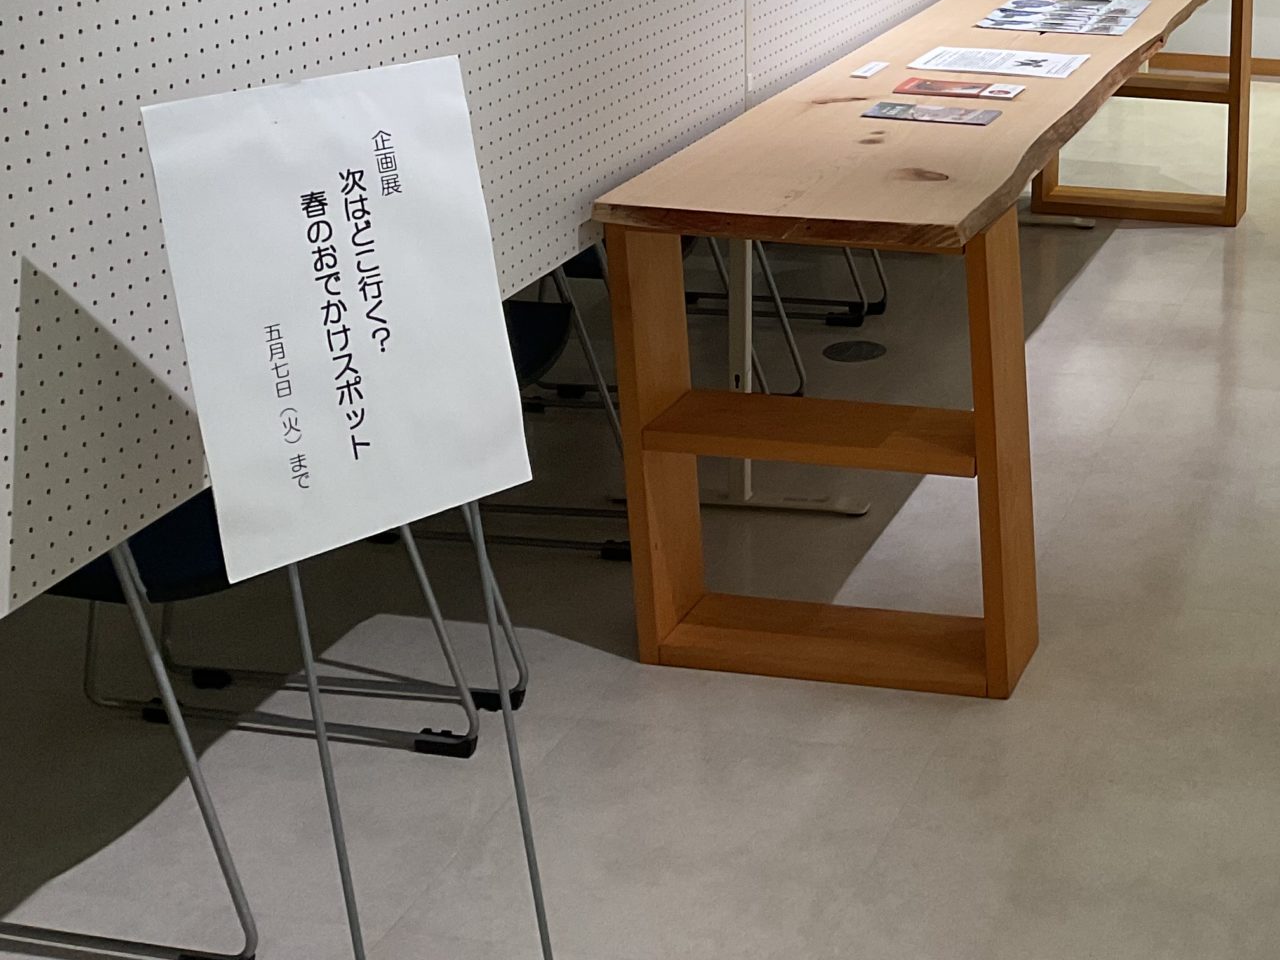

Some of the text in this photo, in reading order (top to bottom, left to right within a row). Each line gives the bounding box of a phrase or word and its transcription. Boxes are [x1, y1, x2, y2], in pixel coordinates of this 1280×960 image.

[371, 130, 402, 197] 企画展
[300, 190, 371, 461] 春のおでかけスポット
